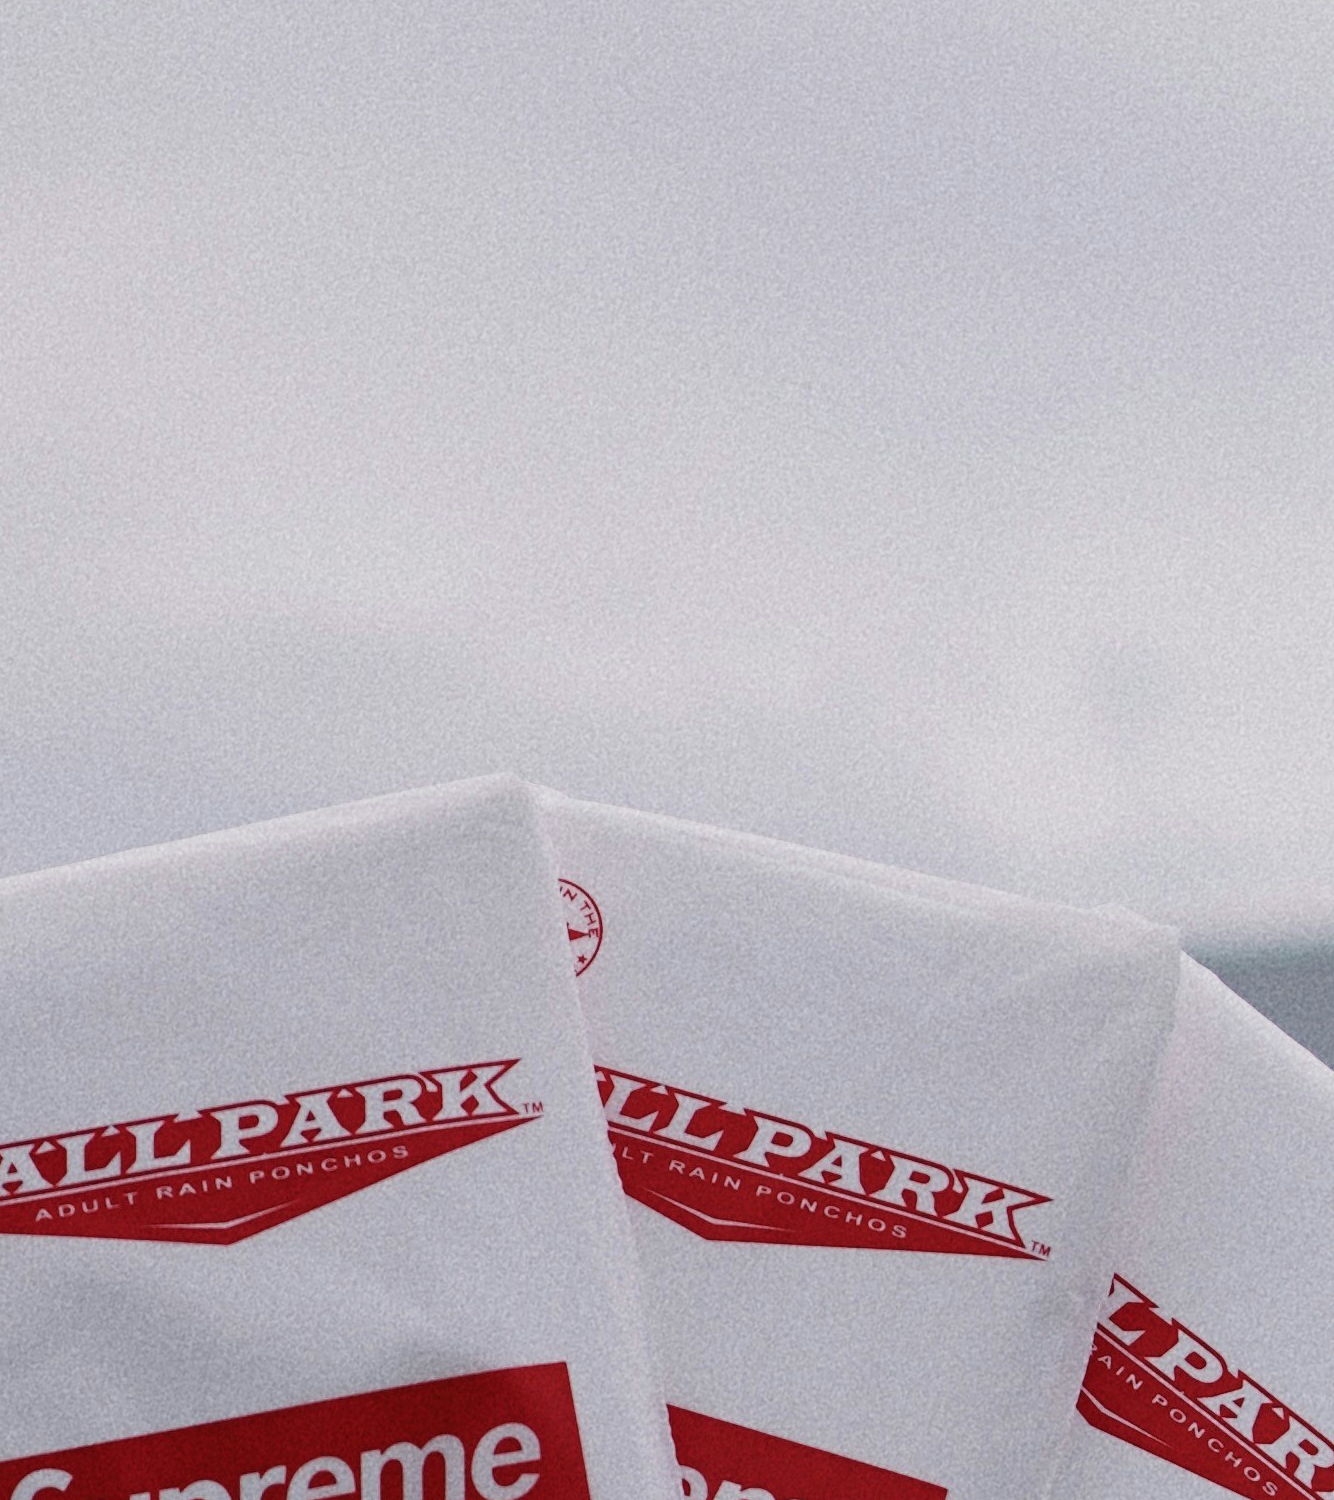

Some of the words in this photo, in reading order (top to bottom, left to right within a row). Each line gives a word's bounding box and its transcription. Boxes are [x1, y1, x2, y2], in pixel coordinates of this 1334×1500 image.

[579, 900, 599, 938] THE
[34, 1190, 139, 1222] ADULT
[156, 1176, 233, 1200] RAIN
[249, 1145, 410, 1185] PONCHOS
[613, 1142, 654, 1164] LT
[668, 1159, 741, 1191] RAIN
[756, 1184, 907, 1239] PONCHOS
[1151, 1393, 1279, 1497] PONCHOS
